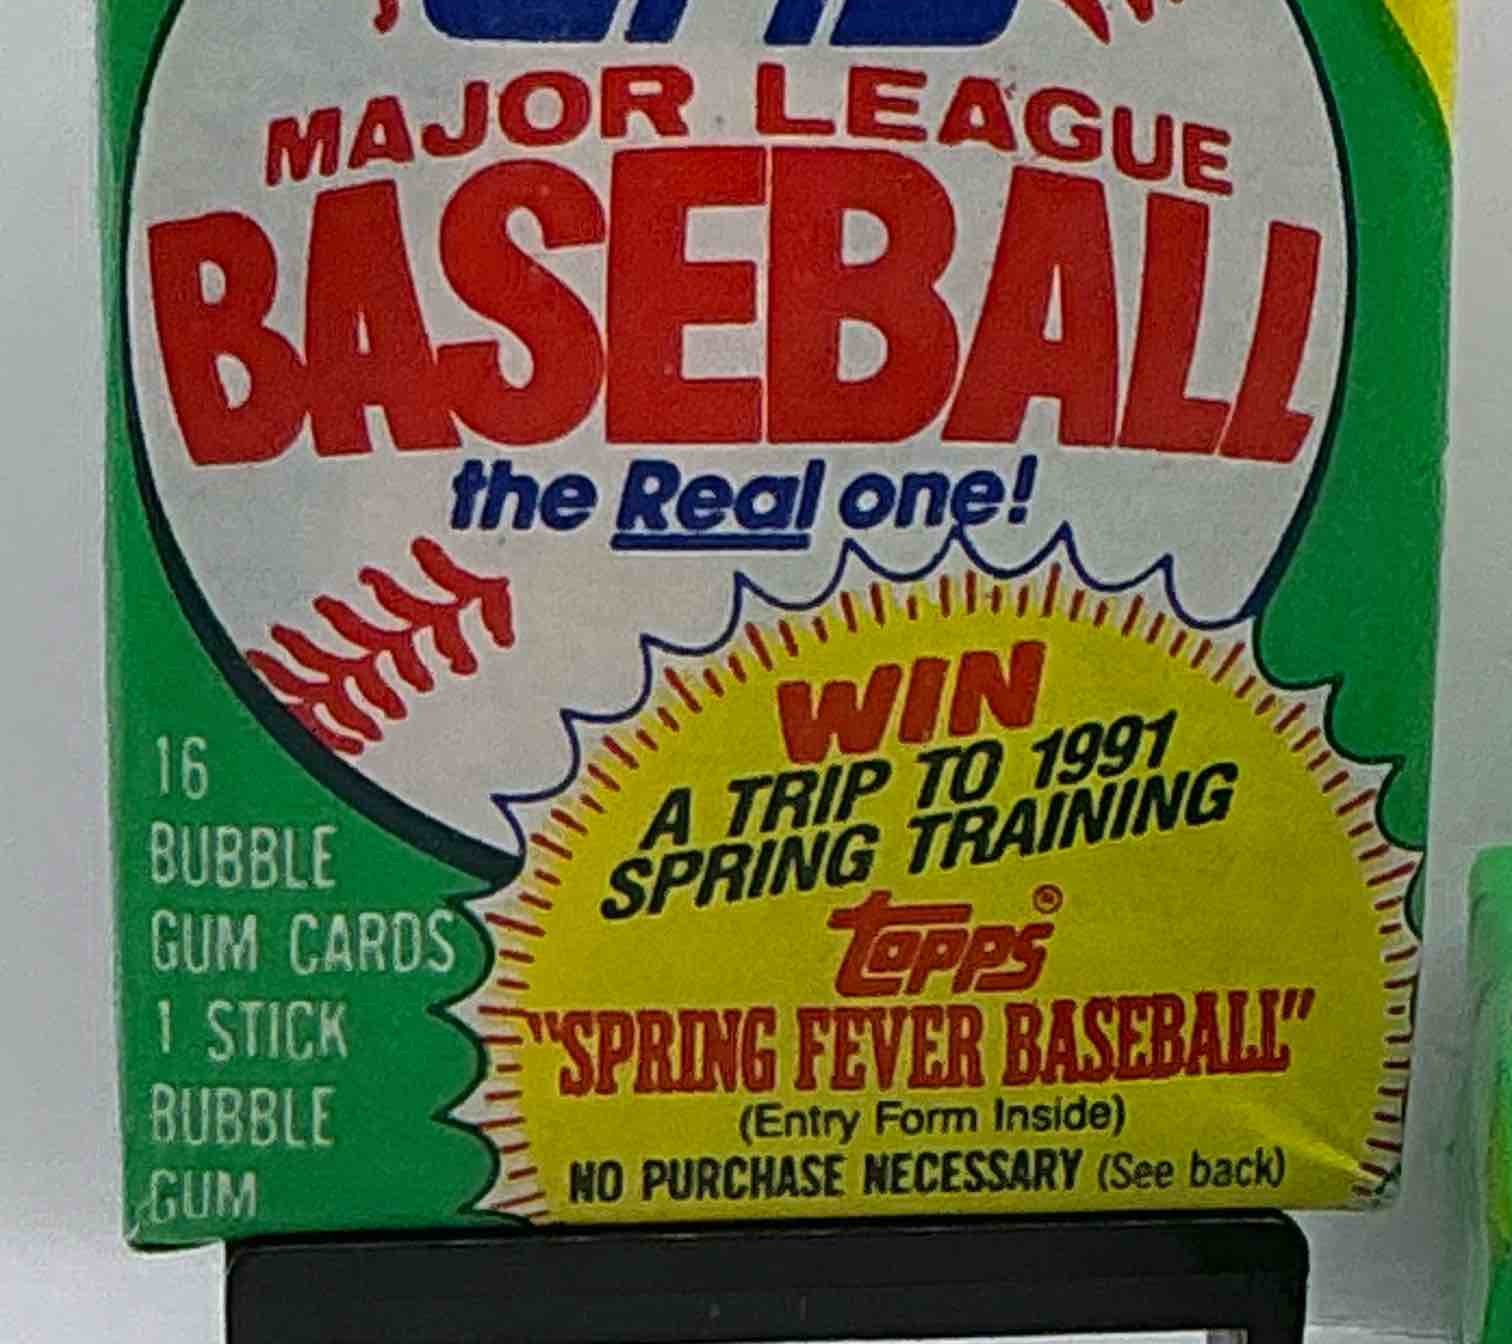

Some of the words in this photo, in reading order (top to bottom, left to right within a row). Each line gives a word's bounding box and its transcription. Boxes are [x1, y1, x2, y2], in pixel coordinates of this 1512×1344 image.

[266, 65, 690, 184] MAJOR
[756, 65, 1232, 195] LEAGUE
[148, 145, 1322, 467] BASEBALL
[451, 459, 597, 531] the
[611, 459, 826, 550] Real
[839, 455, 1038, 530] one!
[777, 640, 1046, 763] WIN
[157, 735, 209, 800] 16
[641, 787, 691, 851] A
[728, 758, 892, 837] TRIP
[915, 740, 1004, 809] TO
[1032, 709, 1178, 790] 1991
[151, 821, 336, 888] BUBBLE
[601, 822, 880, 920] SPRING
[908, 762, 1239, 874] TRAINING
[151, 909, 257, 974] GUM
[290, 909, 455, 975] CARDS
[158, 999, 171, 1054] 1
[207, 1000, 348, 1061] STICK
[528, 1006, 776, 1096] "SPRING
[795, 1004, 985, 1091] FEVER
[1002, 987, 1316, 1087] BASEBALL"
[151, 1083, 335, 1147] BUBBLE
[740, 1102, 859, 1145] (Entry
[876, 1101, 977, 1135] Form
[995, 1094, 1125, 1136] Inside)
[151, 1168, 257, 1225] GUM
[570, 1160, 623, 1204] NO
[642, 1154, 845, 1201] PURCHASE
[864, 1148, 1083, 1196] NECESSARY
[1098, 1152, 1174, 1192] (See
[1190, 1146, 1286, 1190] back)
